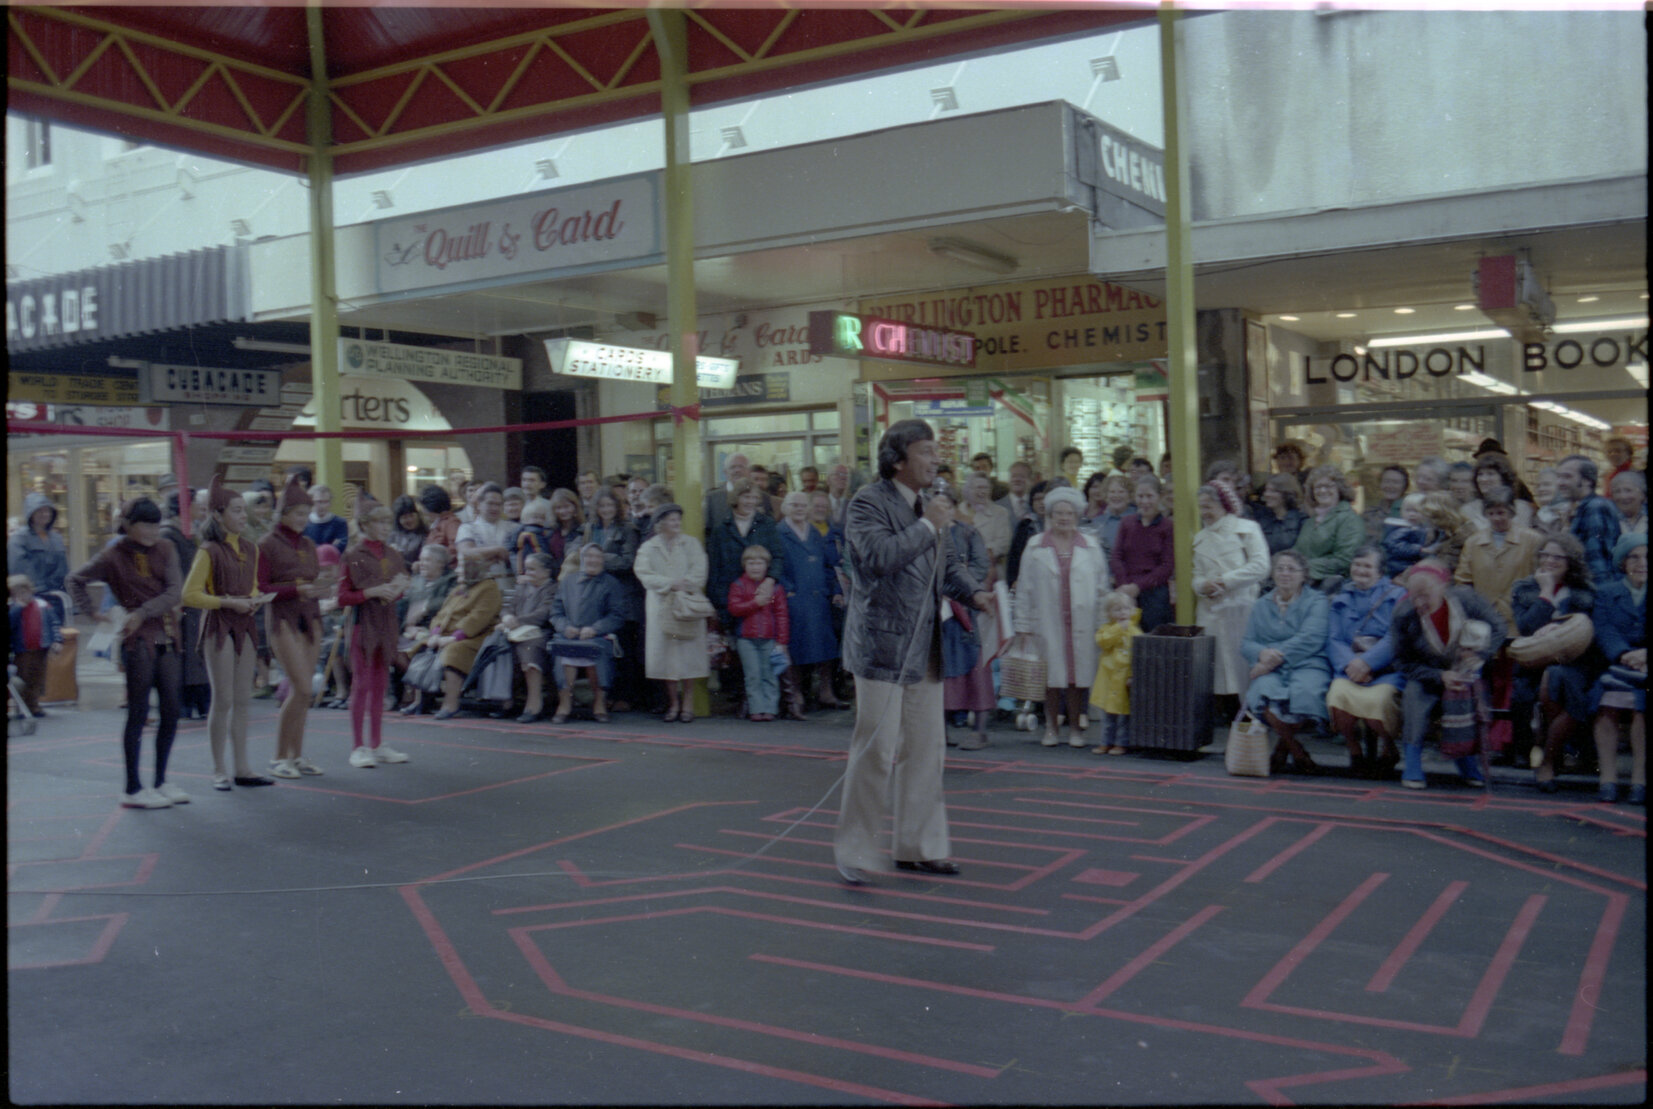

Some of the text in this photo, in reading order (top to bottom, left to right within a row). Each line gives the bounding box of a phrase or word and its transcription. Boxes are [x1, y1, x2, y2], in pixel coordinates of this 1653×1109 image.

[424, 199, 625, 270] Quill & Card
[870, 291, 1022, 327] RLINGTON
[869, 321, 976, 364] CHEMIST
[1047, 321, 1166, 350] CHEMIST
[365, 343, 514, 373] WELLINGTON REGIONAL
[569, 359, 664, 381] STATIONERY
[597, 347, 645, 365] CARDS
[1305, 335, 1648, 385] LONDON BOOK
[168, 368, 266, 394] CUBACADE
[365, 359, 509, 385] PLANNING AUTHORITY
